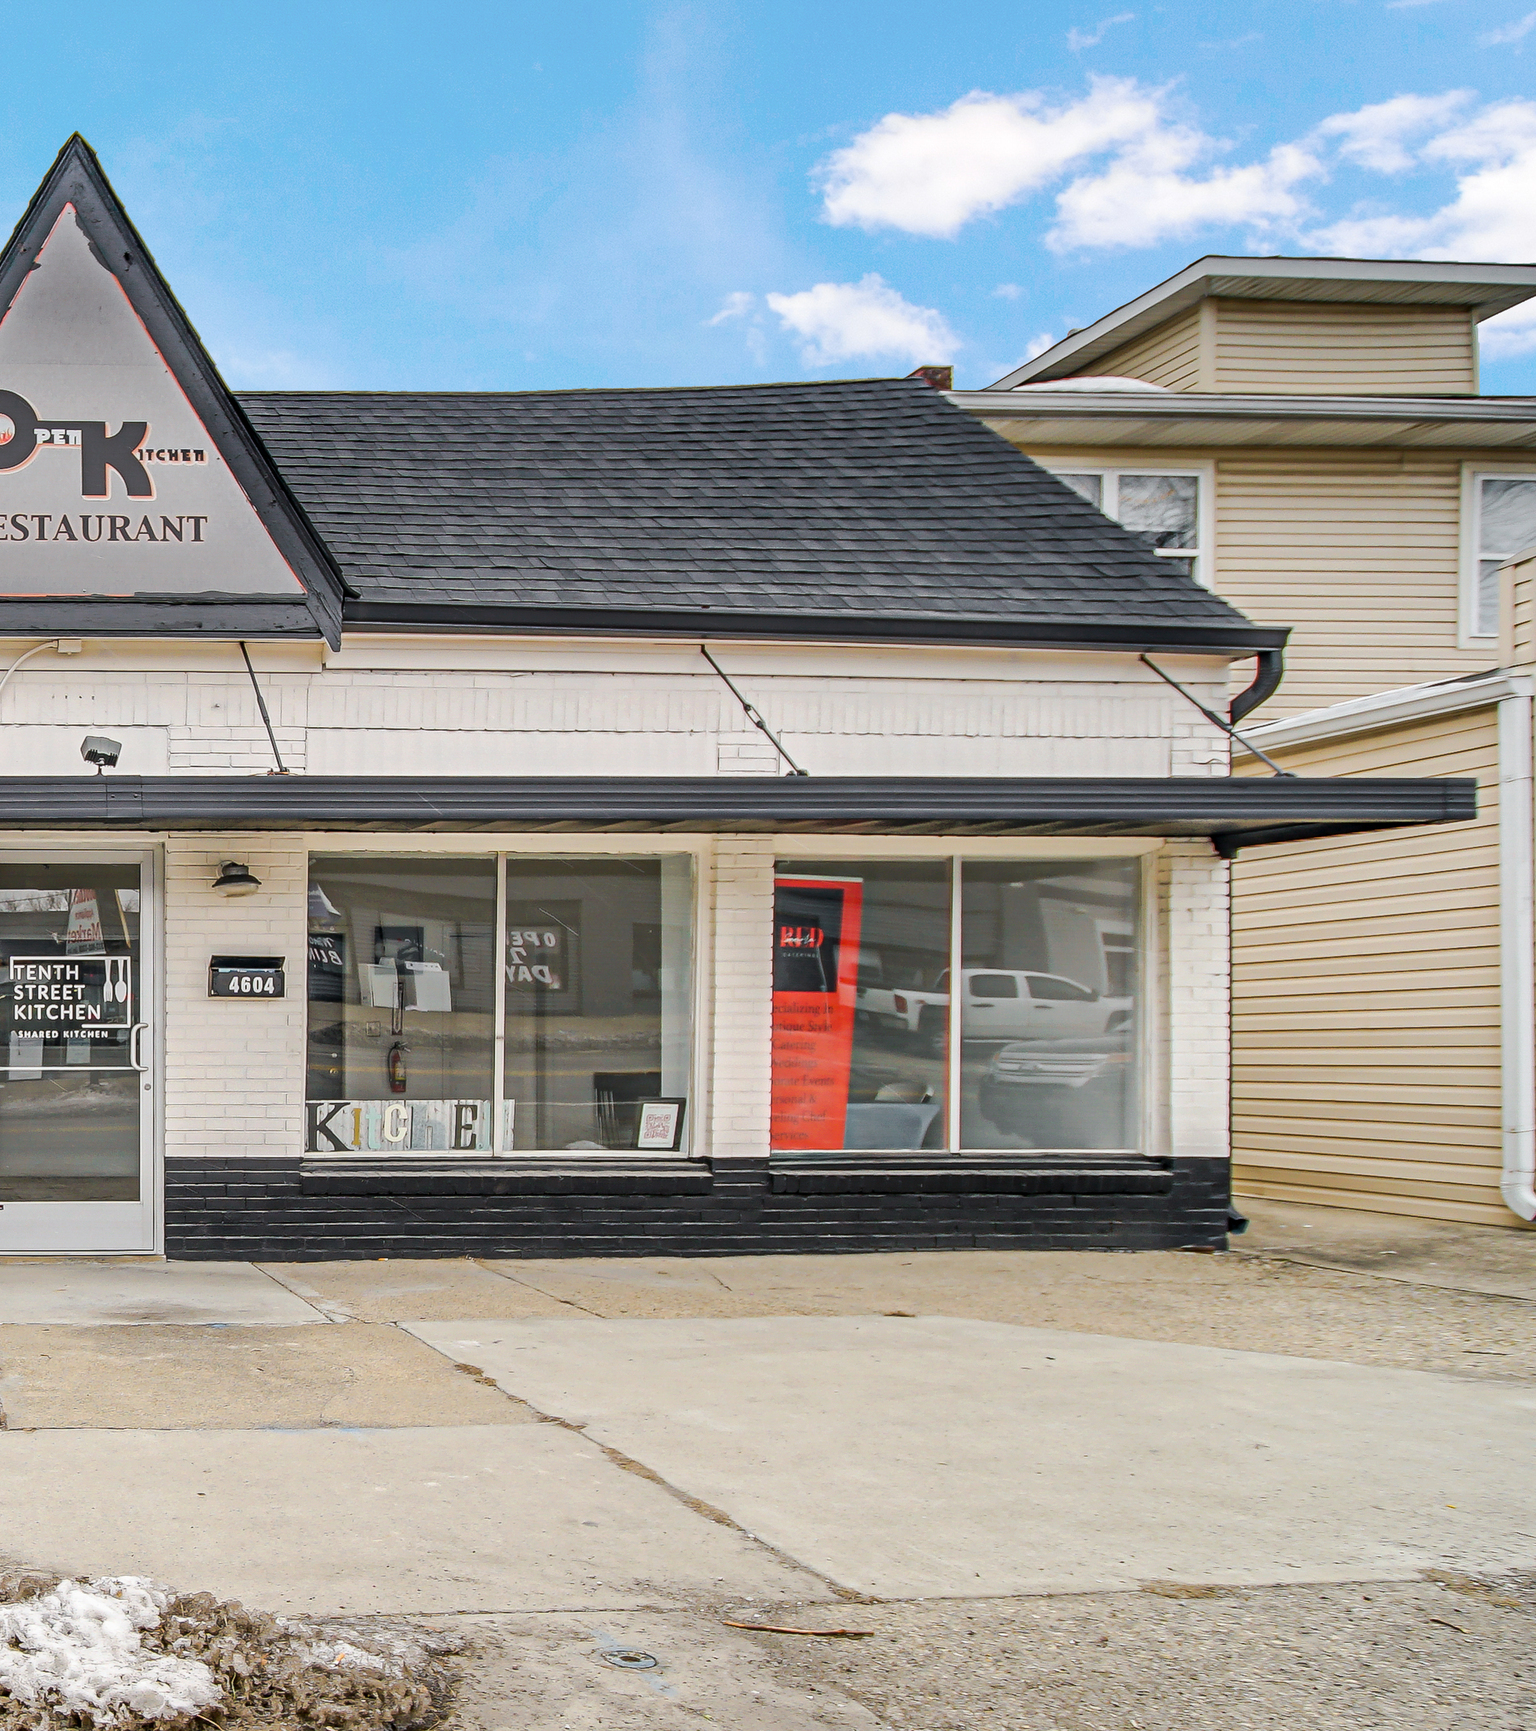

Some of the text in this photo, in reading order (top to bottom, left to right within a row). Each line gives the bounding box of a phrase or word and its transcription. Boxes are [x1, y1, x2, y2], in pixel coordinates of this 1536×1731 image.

[14, 965, 79, 980] TENTH
[13, 984, 85, 1000] STREET
[228, 976, 275, 994] 4604
[14, 1004, 101, 1020] KITCHEN
[18, 1030, 108, 1039] SHARED KITCHEN
